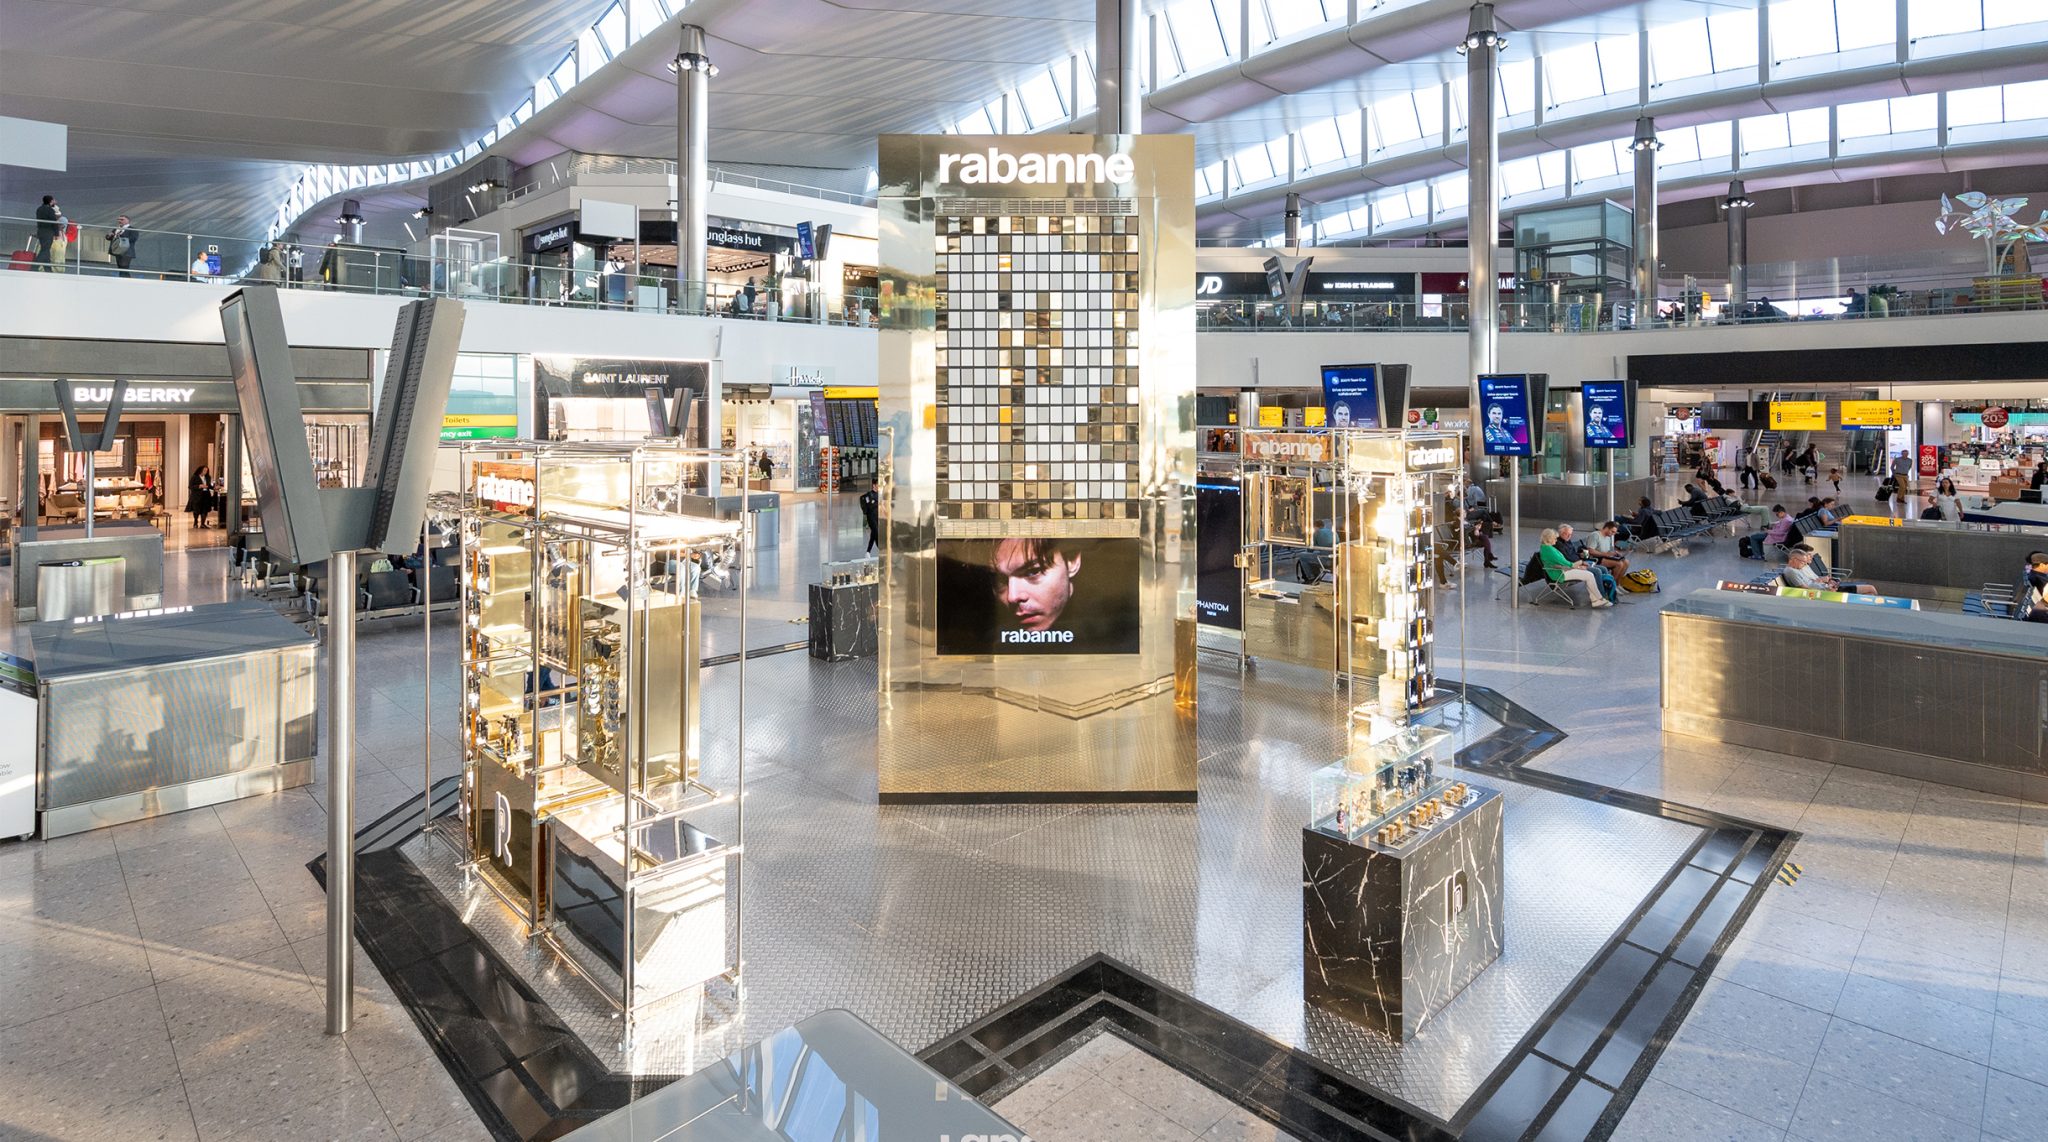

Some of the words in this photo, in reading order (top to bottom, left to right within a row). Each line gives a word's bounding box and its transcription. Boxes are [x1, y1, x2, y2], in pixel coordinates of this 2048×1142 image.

[939, 147, 1134, 184] rabanne
[706, 230, 743, 245] unglass
[745, 233, 762, 247] hut
[1197, 276, 1222, 294] JD
[583, 372, 617, 384] SAINT
[619, 373, 669, 384] LAURENT
[1252, 438, 1322, 457] rabanne
[1408, 445, 1455, 466] rabanne
[1196, 599, 1229, 612] PHANTOM
[1001, 629, 1074, 643] rabanne
